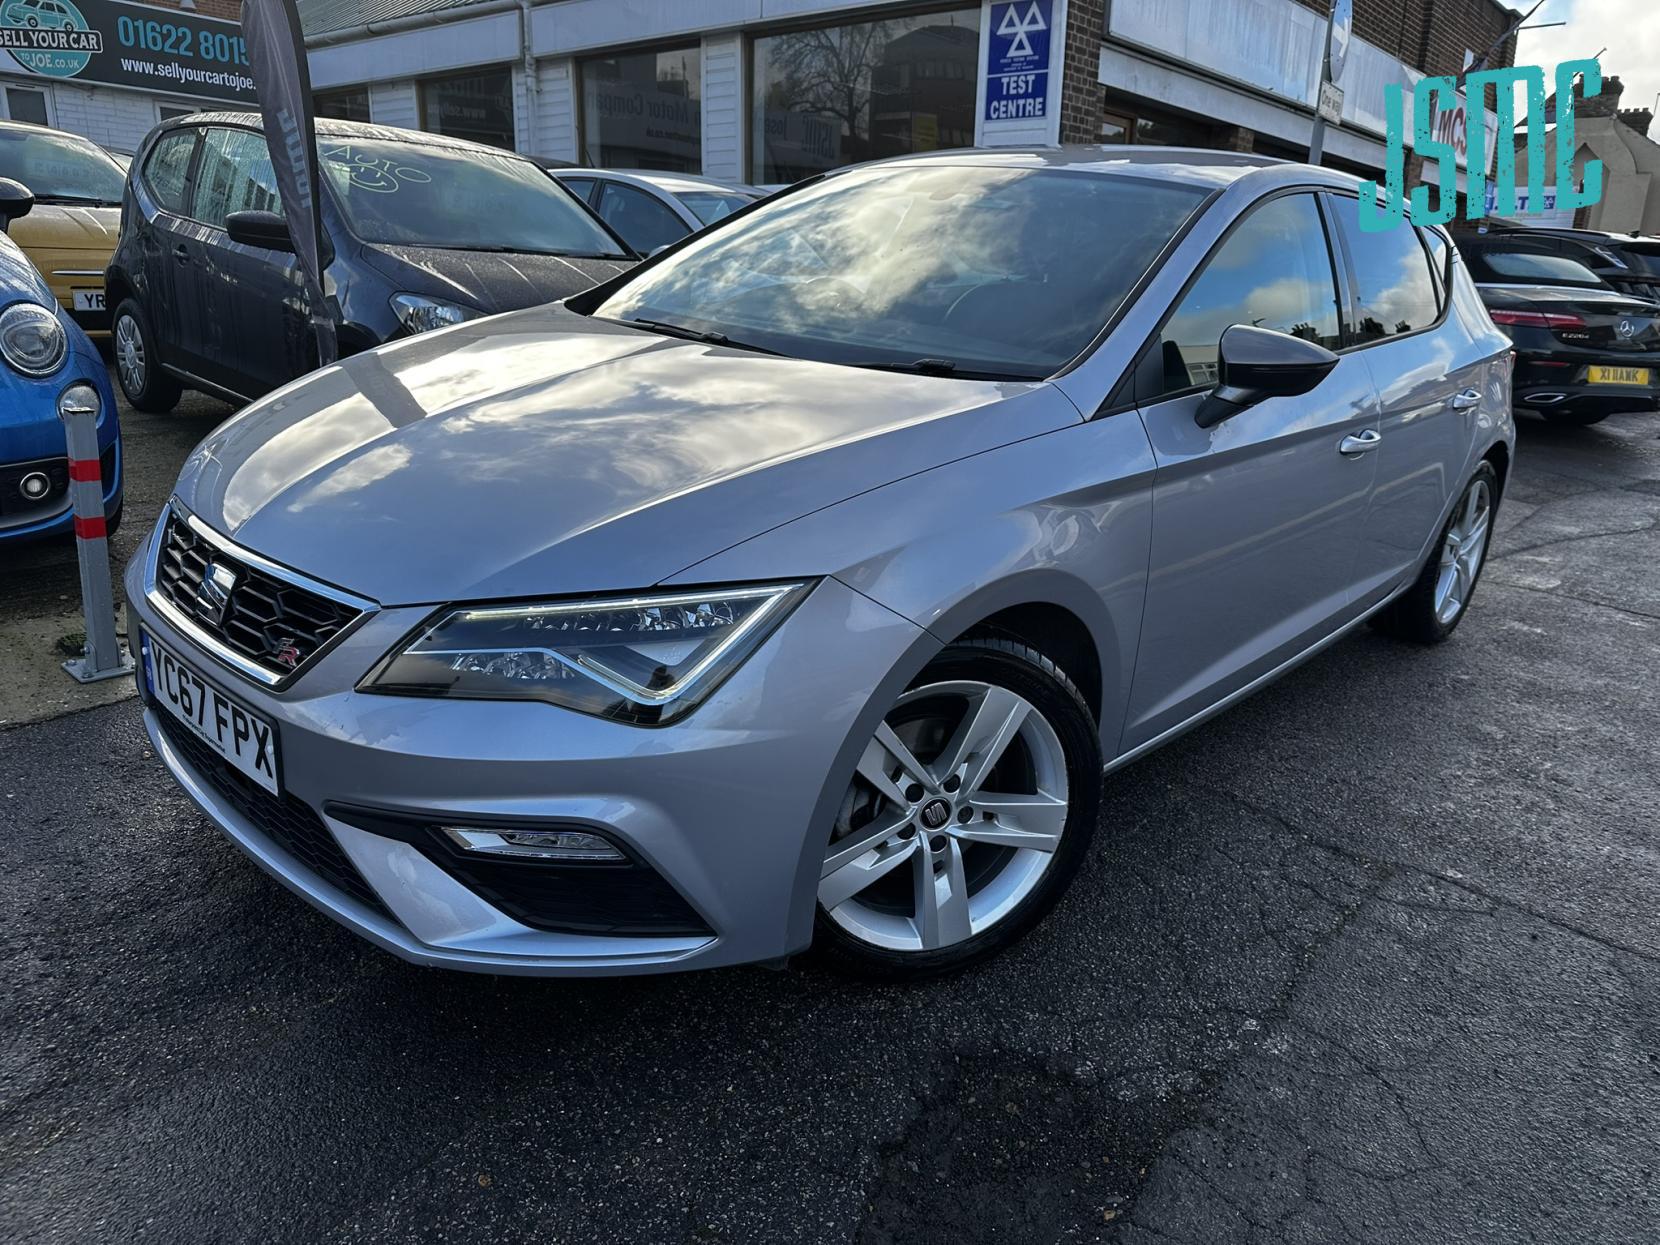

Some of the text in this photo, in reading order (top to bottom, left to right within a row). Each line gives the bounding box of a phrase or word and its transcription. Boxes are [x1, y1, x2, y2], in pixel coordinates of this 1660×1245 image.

[29, 31, 69, 48] YOUR
[70, 33, 99, 50] CAR
[117, 16, 194, 57] 01622
[1001, 74, 1036, 95] TEST
[990, 97, 1044, 119] CENTRE
[323, 145, 432, 183] AUTO
[84, 293, 106, 309] YR
[151, 641, 205, 727] YC67
[214, 692, 273, 778] FPX
